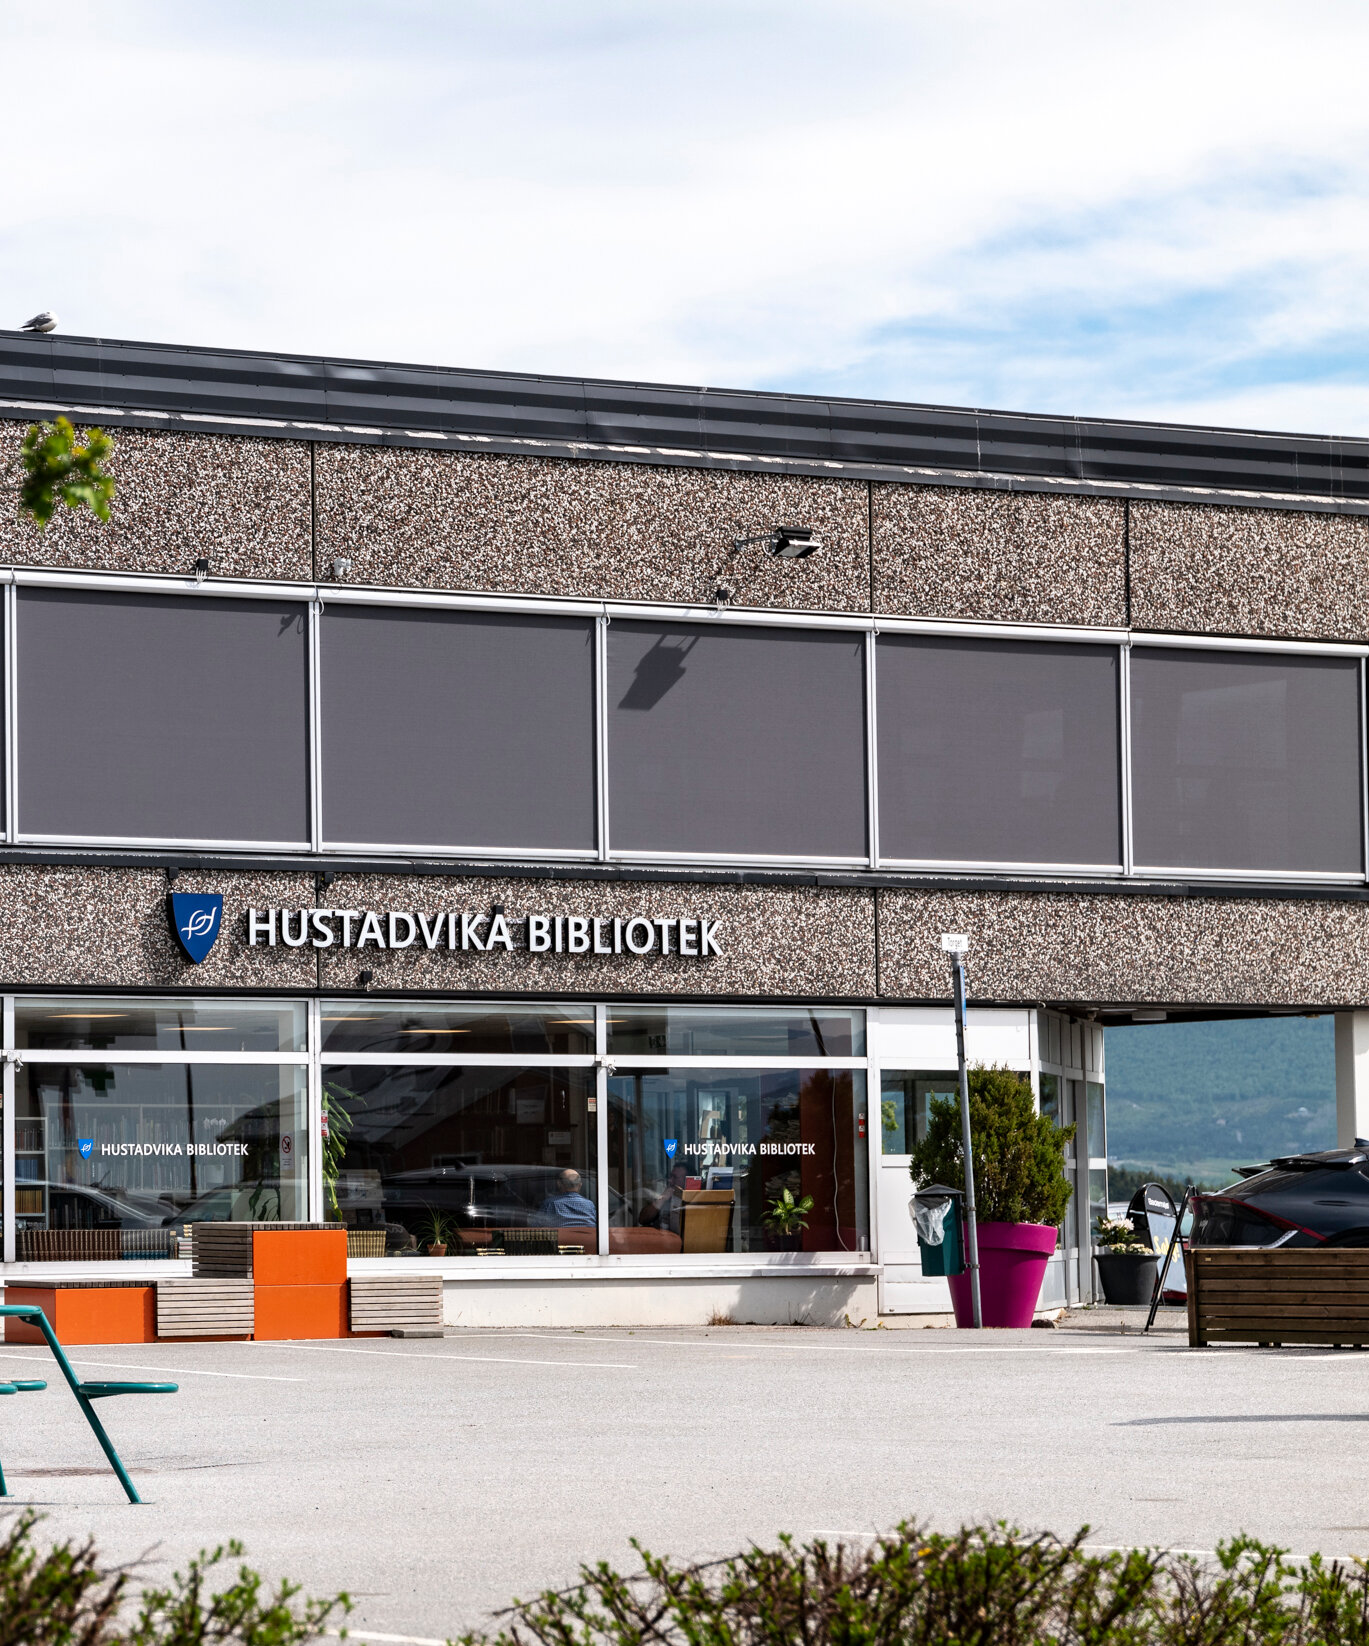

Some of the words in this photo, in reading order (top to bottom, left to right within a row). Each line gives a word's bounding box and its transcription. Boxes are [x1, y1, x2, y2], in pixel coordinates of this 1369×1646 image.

[248, 908, 514, 951] HUSTADVIKA
[529, 915, 725, 956] BIBLIOTEK
[101, 1143, 183, 1156] HUSTADVIKA
[186, 1143, 249, 1156] BIBLIOTEK
[684, 1143, 757, 1155] HUSTADVIKA
[760, 1143, 816, 1155] BIBLIOTEK
